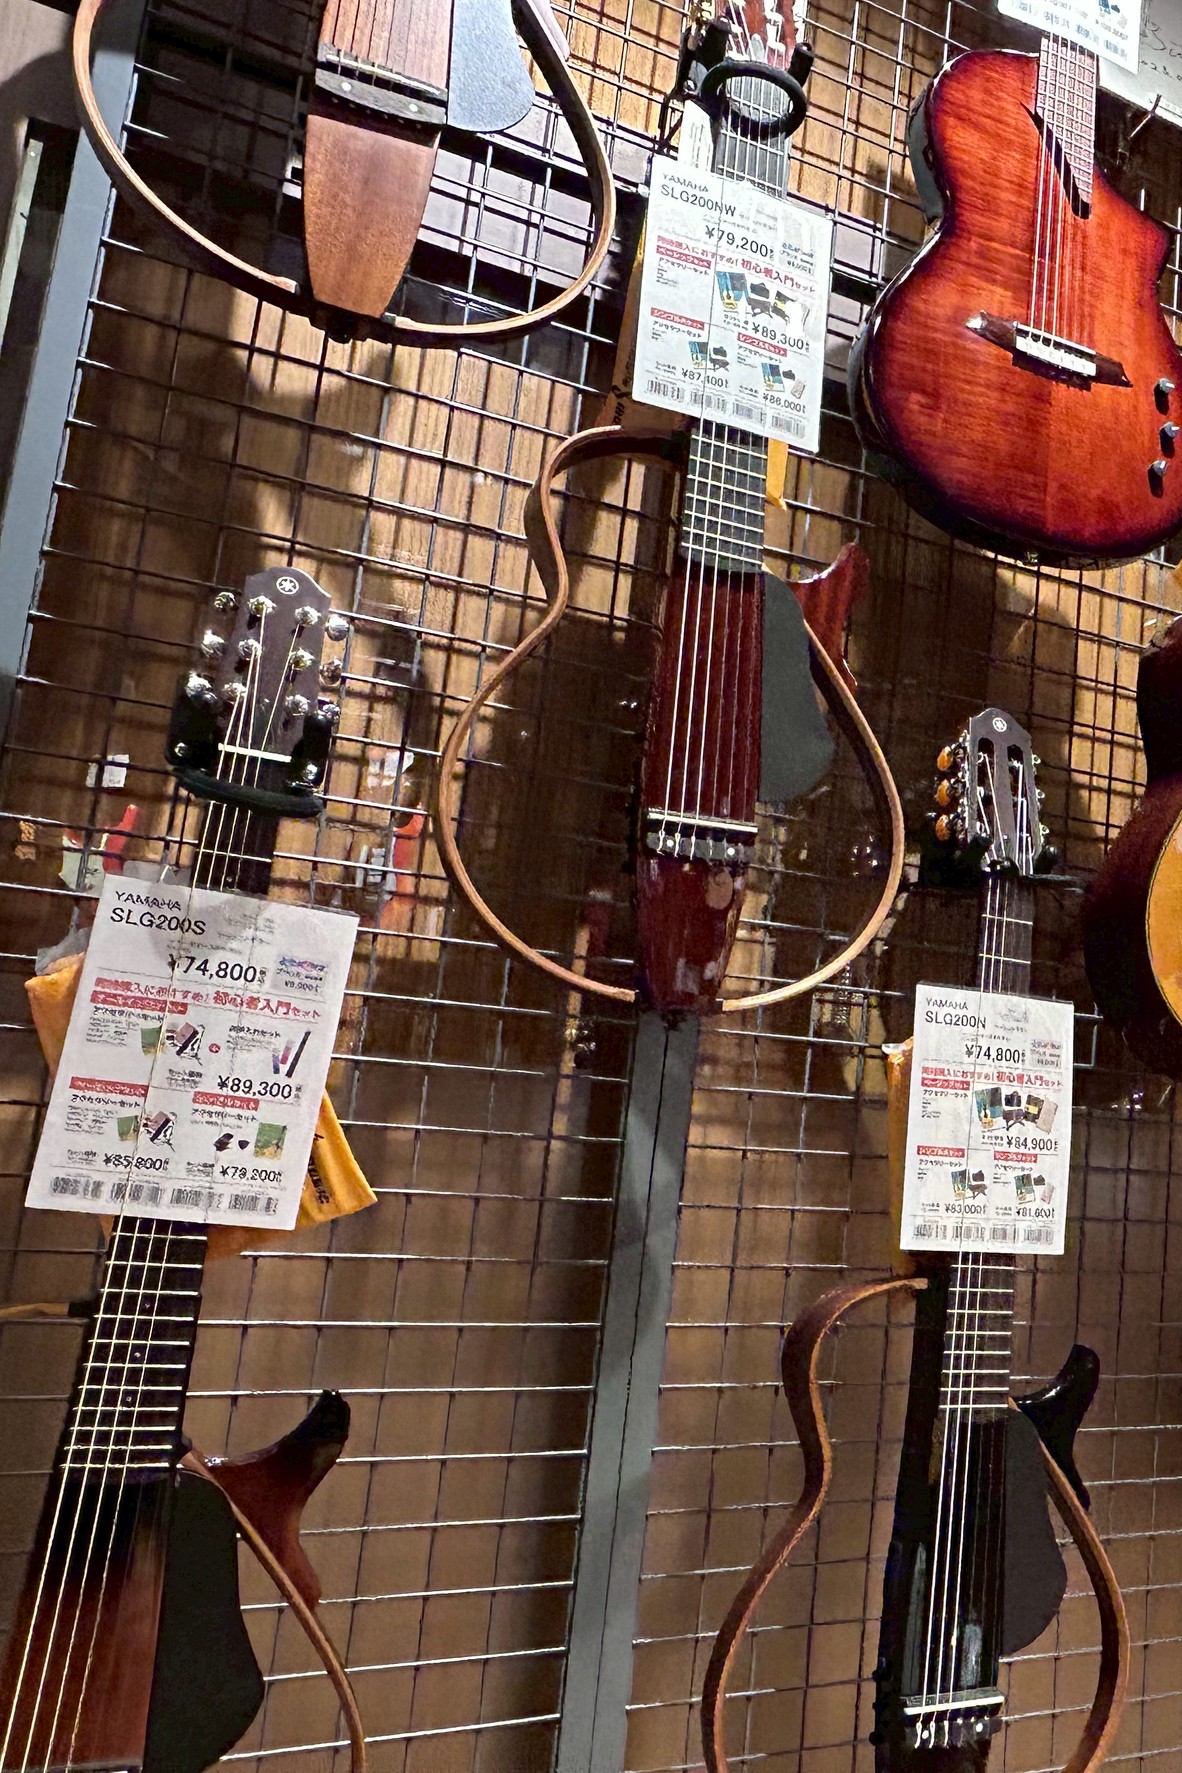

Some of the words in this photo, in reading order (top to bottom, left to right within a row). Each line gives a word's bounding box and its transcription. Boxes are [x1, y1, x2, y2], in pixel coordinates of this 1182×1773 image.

[663, 173, 709, 192] YAMAHA
[661, 184, 736, 217] SLG200NW
[705, 225, 768, 258] ¥79,200
[752, 322, 804, 350] ¥89,300
[115, 890, 181, 911] YAMAHA
[110, 907, 206, 935] SLG200S
[168, 953, 257, 983] ¥74,800
[926, 997, 968, 1011] YAMAHA
[925, 1010, 986, 1029] SLG200N
[965, 1044, 1020, 1064] ¥74,800
[218, 1075, 292, 1100] ¥89,300
[1006, 1135, 1052, 1151] ¥84,900
